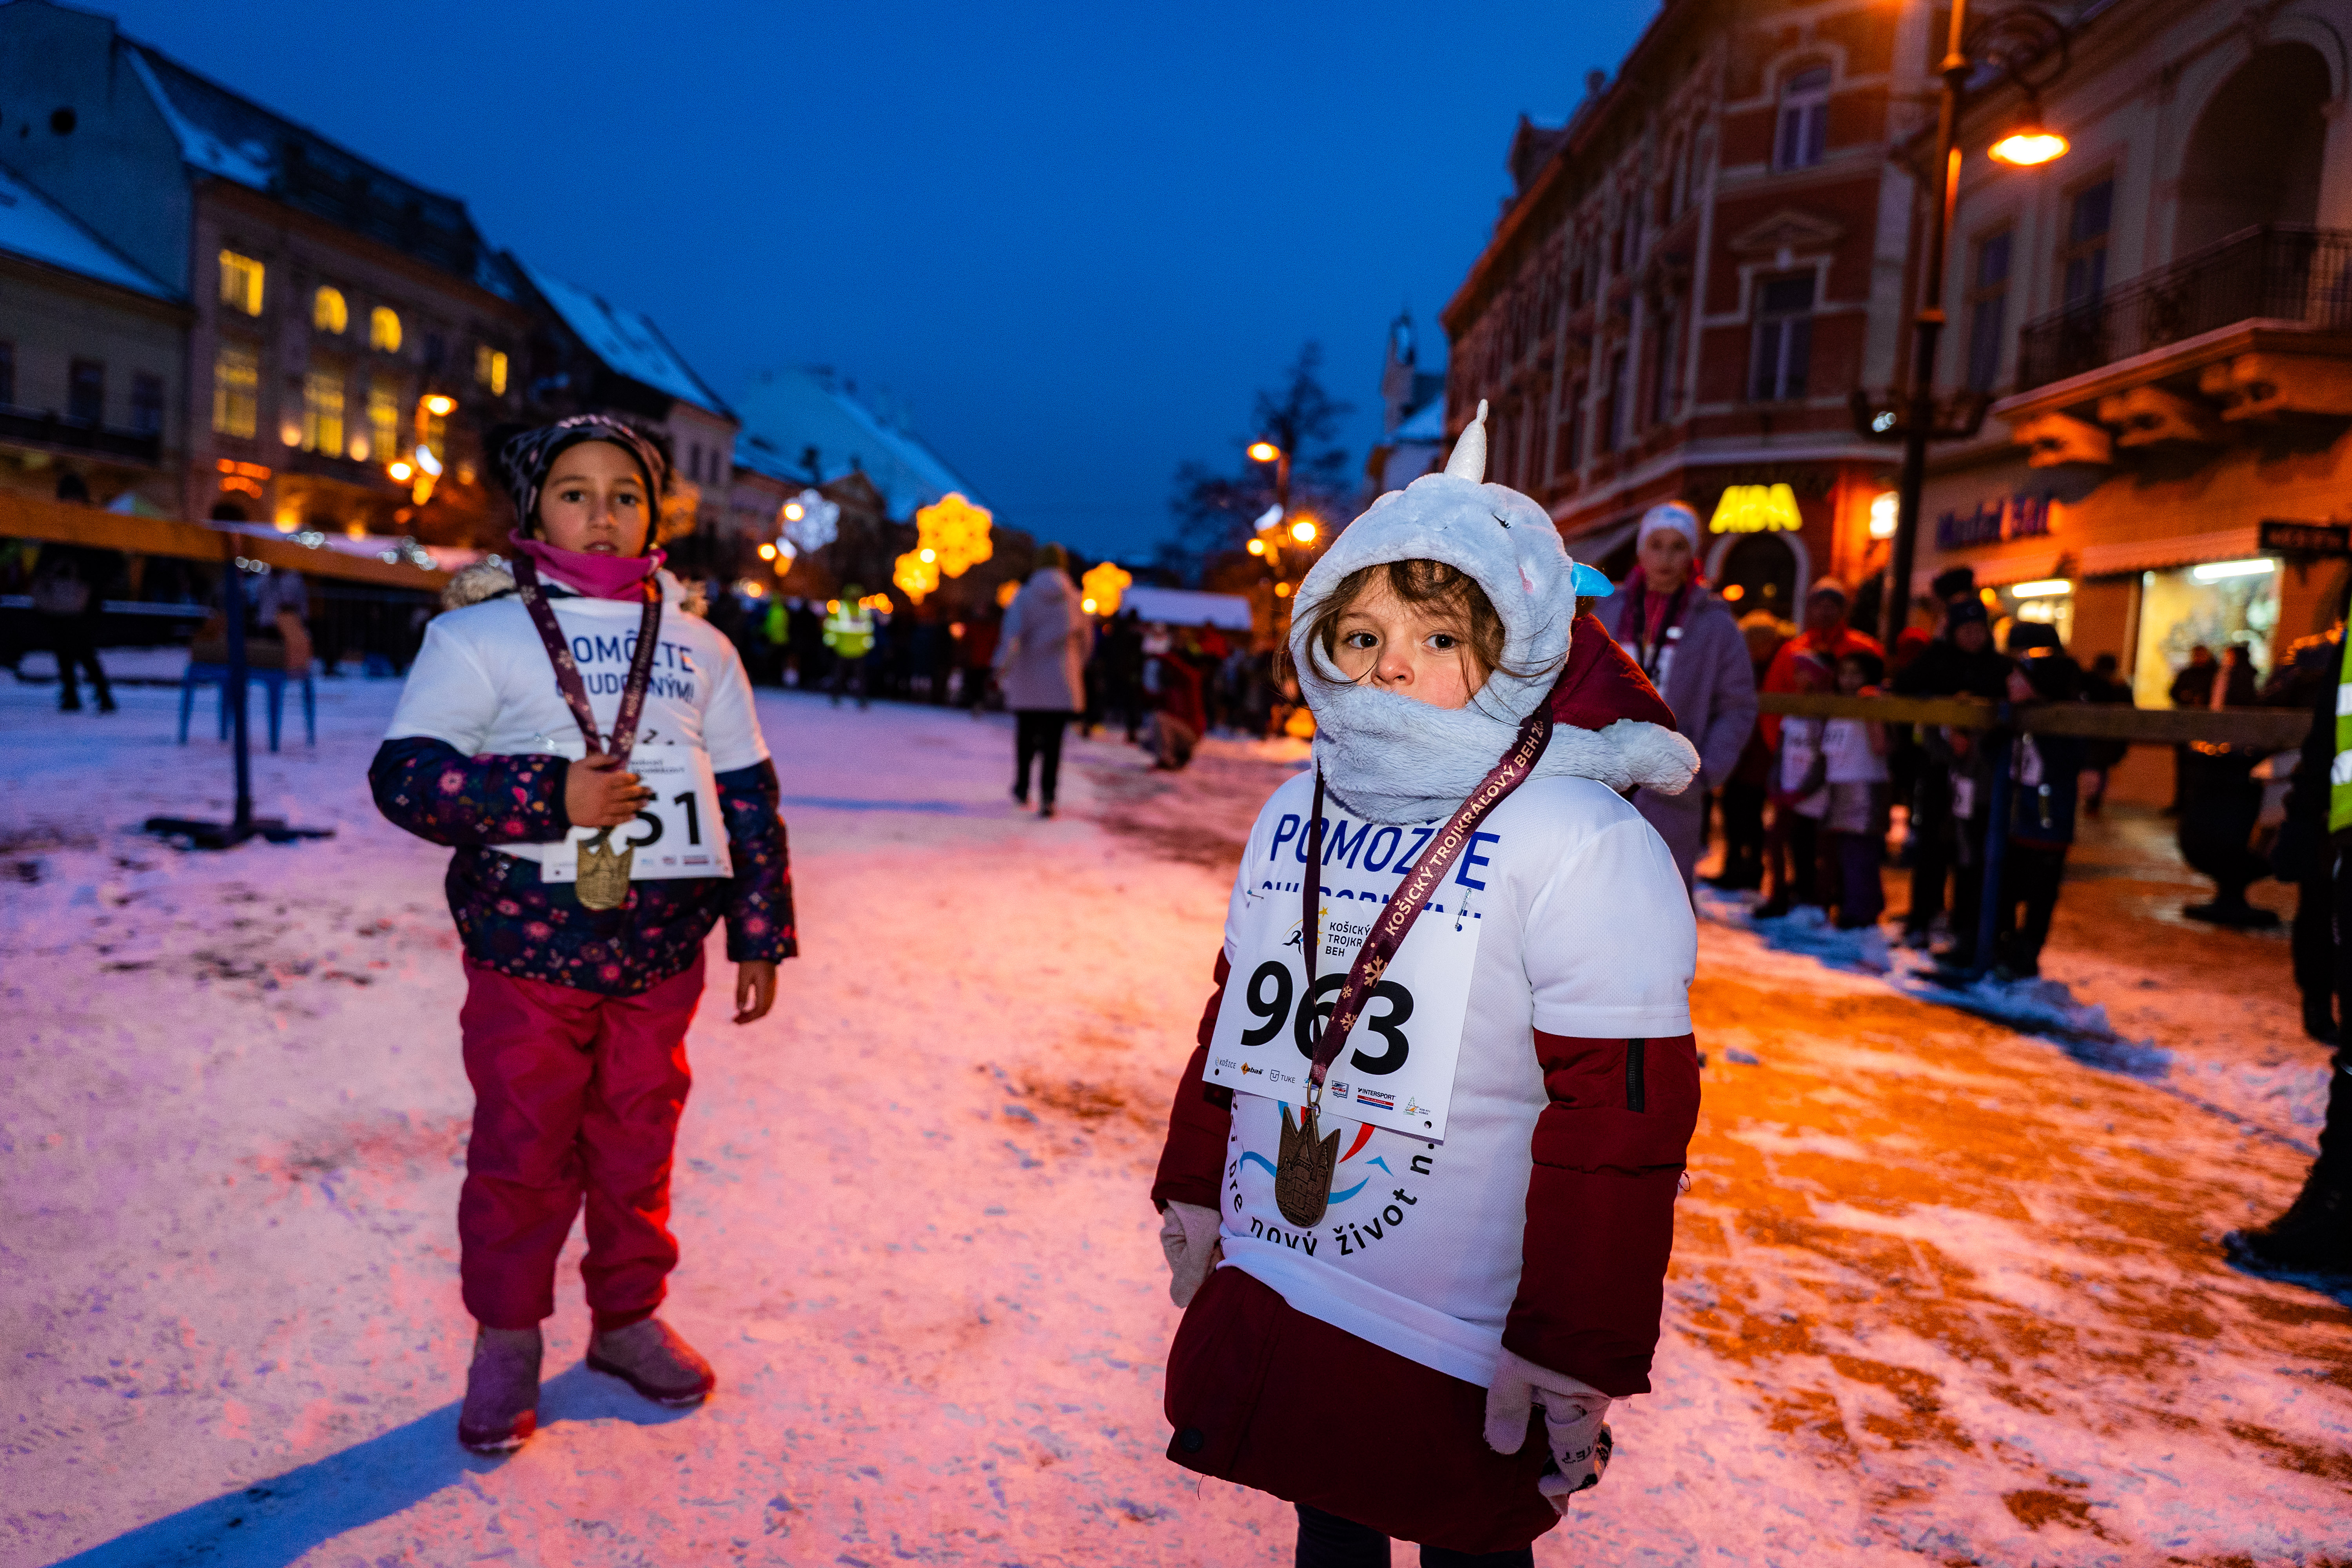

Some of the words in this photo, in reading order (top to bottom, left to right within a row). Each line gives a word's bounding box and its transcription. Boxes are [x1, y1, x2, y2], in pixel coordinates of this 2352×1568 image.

[1385, 866, 1434, 936] KOŠICKÝ
[1430, 764, 1515, 866] TROJKRÁĽOVÝ
[1514, 735, 1539, 768] BEH
[1329, 921, 1371, 936] KOŠICKÝ
[1328, 934, 1363, 947] TROJKR
[1325, 946, 1345, 957] BEH
[1240, 960, 1414, 1075] 963
[1219, 1059, 1236, 1069] KOŠICE
[1281, 1074, 1296, 1083] TUKE
[1362, 1088, 1396, 1100] INTERSPORT
[1250, 1216, 1318, 1256] nový
[1332, 1188, 1417, 1256] život
